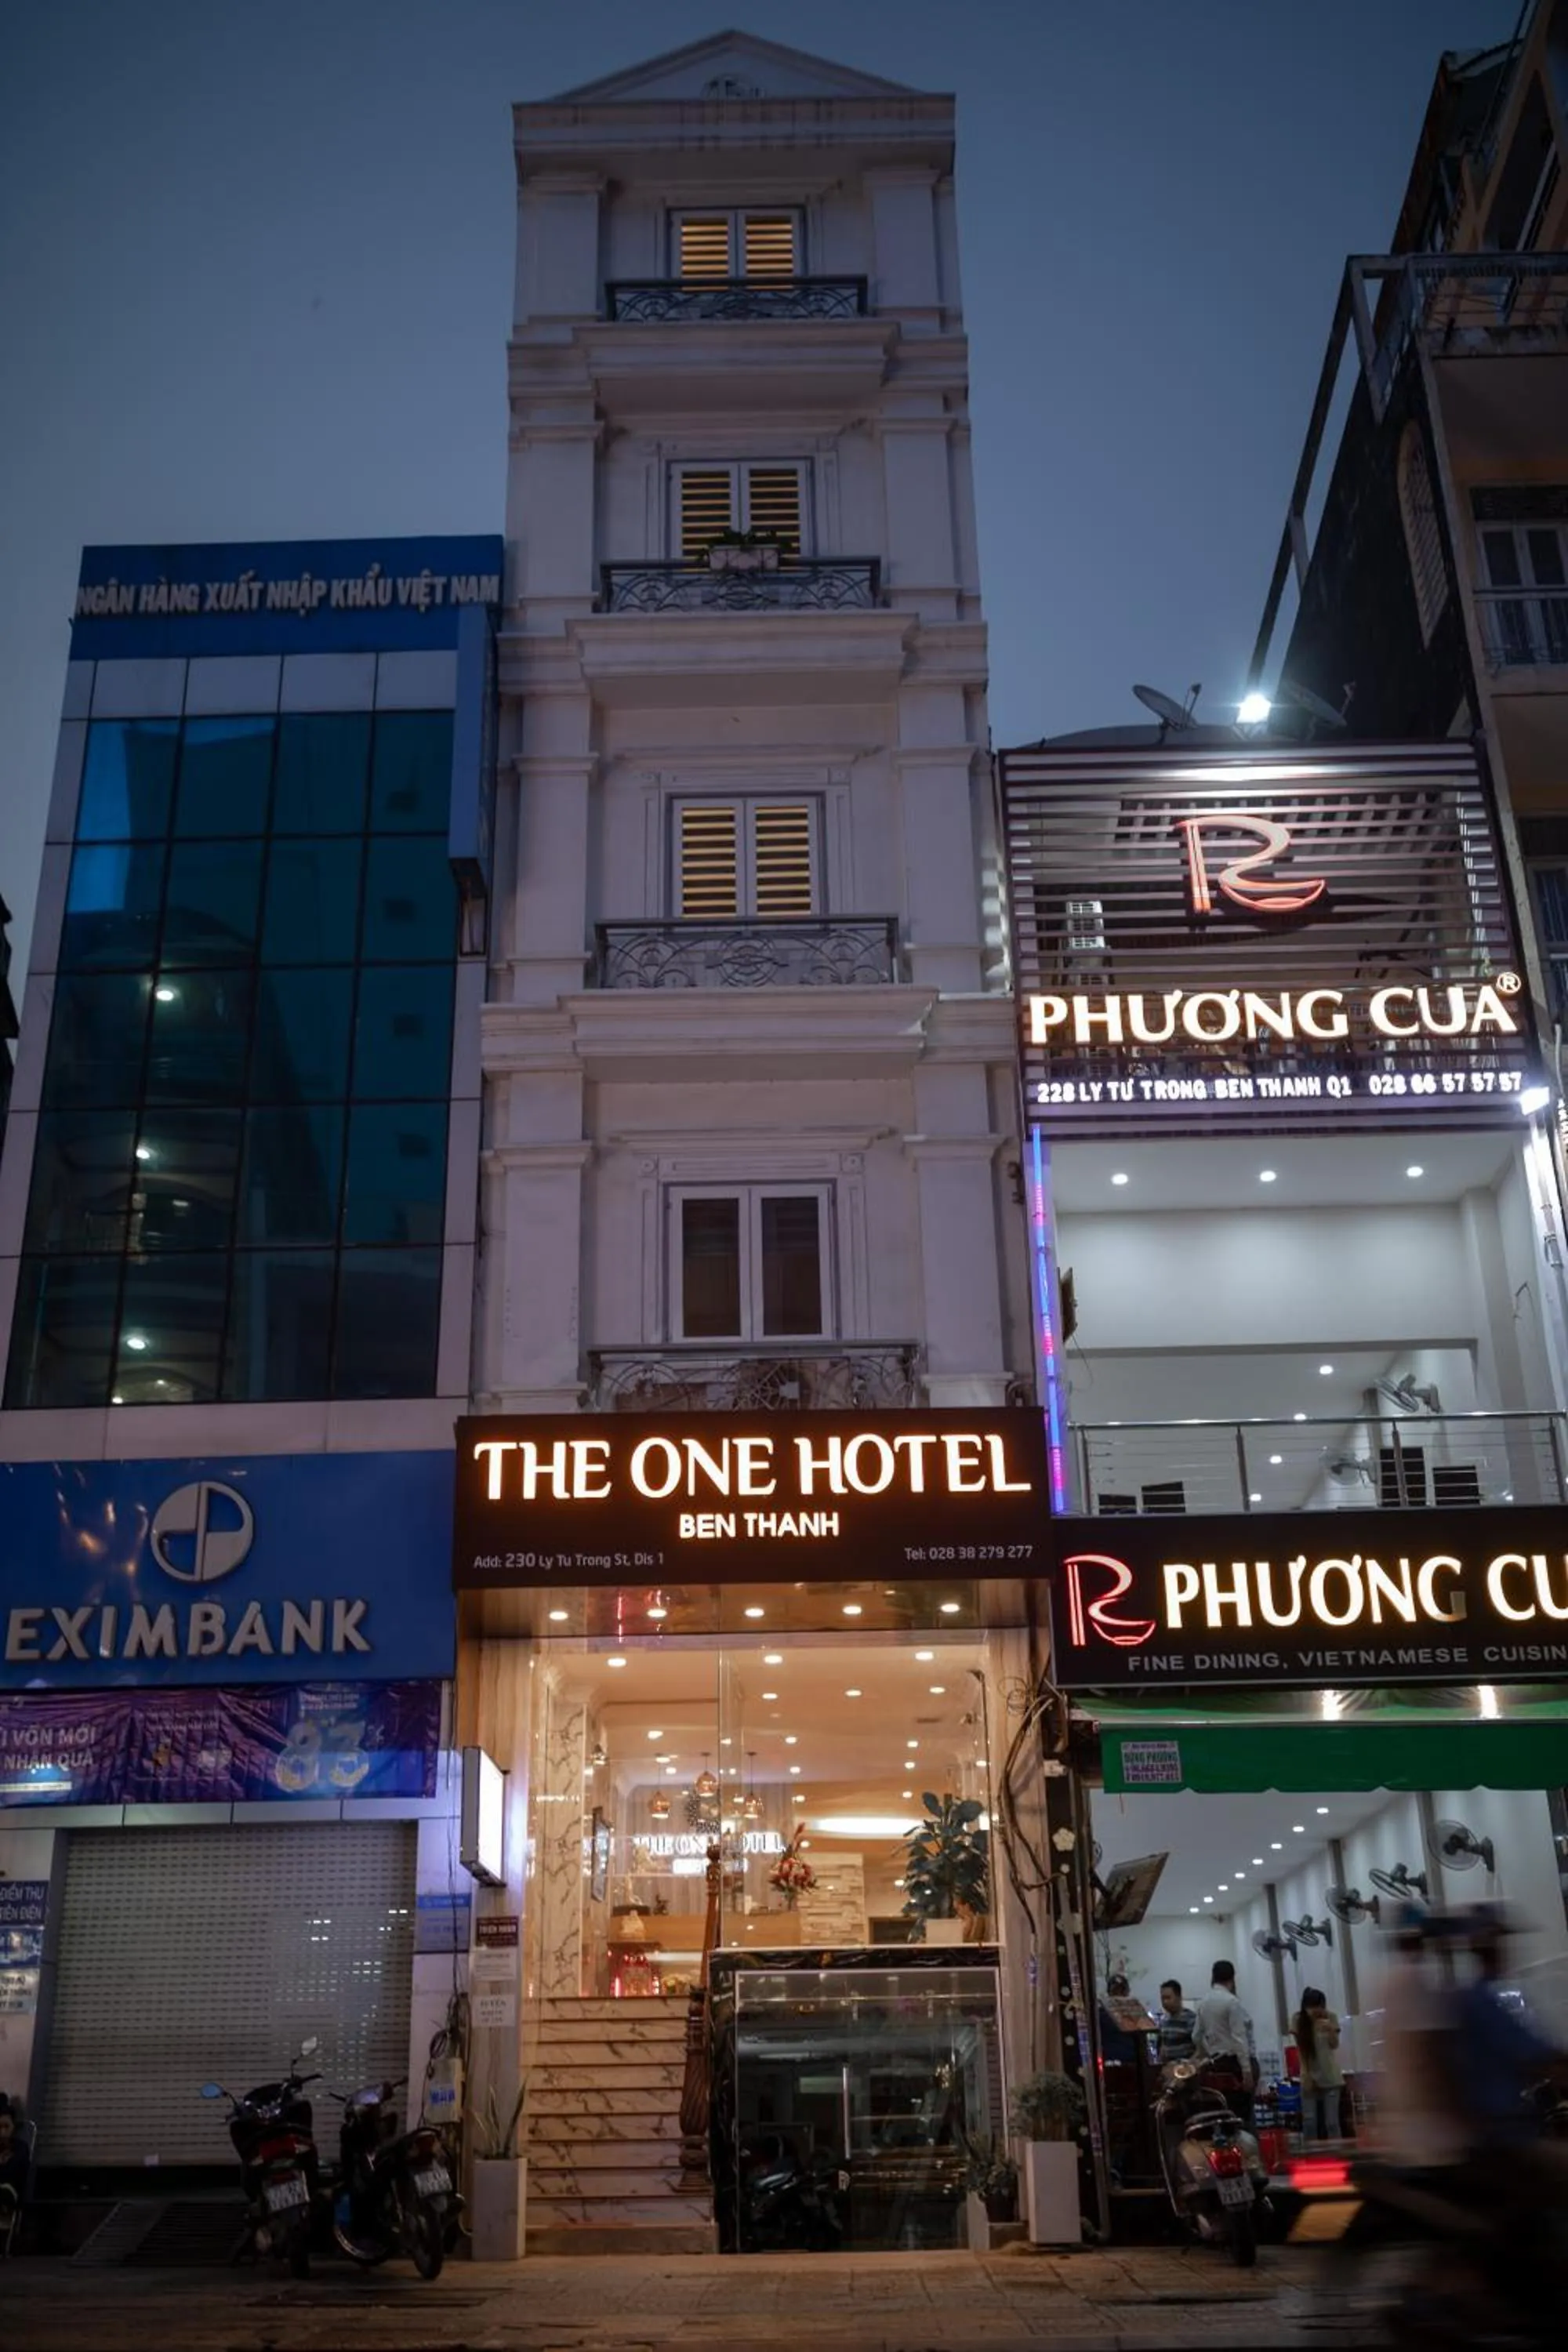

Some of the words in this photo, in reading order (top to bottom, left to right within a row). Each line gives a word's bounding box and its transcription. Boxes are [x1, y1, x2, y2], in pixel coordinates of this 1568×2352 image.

[76, 578, 136, 615] NGÂN
[138, 577, 200, 612] HÀNG
[204, 570, 264, 611] XUẤT
[266, 572, 328, 616] NHẬP
[330, 563, 393, 608] KHẨU
[397, 568, 447, 612] VIỆT
[450, 575, 499, 603] NAM
[1029, 989, 1348, 1044] PHƯƠNG
[1037, 1082, 1076, 1103] 228
[1079, 1081, 1103, 1102] LY
[1141, 1079, 1207, 1100] TRONG
[1214, 1078, 1254, 1099] BEN
[1256, 1076, 1321, 1098] THANH
[1326, 1075, 1352, 1098] Q1
[1369, 1074, 1407, 1095] 028
[1442, 1073, 1465, 1093] 57
[1471, 1072, 1495, 1092] 57
[1498, 1072, 1522, 1092] 57
[474, 1440, 612, 1500] THE
[630, 1437, 776, 1498] ONE
[793, 1433, 1032, 1495] HOTEL
[679, 1513, 736, 1538] BEN
[743, 1512, 839, 1537] THANH
[474, 1554, 502, 1569] Add:
[505, 1552, 535, 1569] 230
[538, 1554, 554, 1570] Ly
[556, 1554, 572, 1568] Tu
[575, 1553, 612, 1570] Trong
[634, 1552, 654, 1566] Dis
[658, 1552, 664, 1566] 1
[904, 1547, 926, 1561] Tel:
[928, 1547, 956, 1560] 028
[958, 1546, 976, 1560] 38
[978, 1545, 1004, 1559] 279
[1007, 1544, 1033, 1559] 277
[1163, 1554, 1467, 1628] PHƯƠNG
[5, 1599, 372, 1661] EXIMBANK
[1128, 1655, 1185, 1671] FINE
[1298, 1647, 1468, 1667] VIETNAMESE
